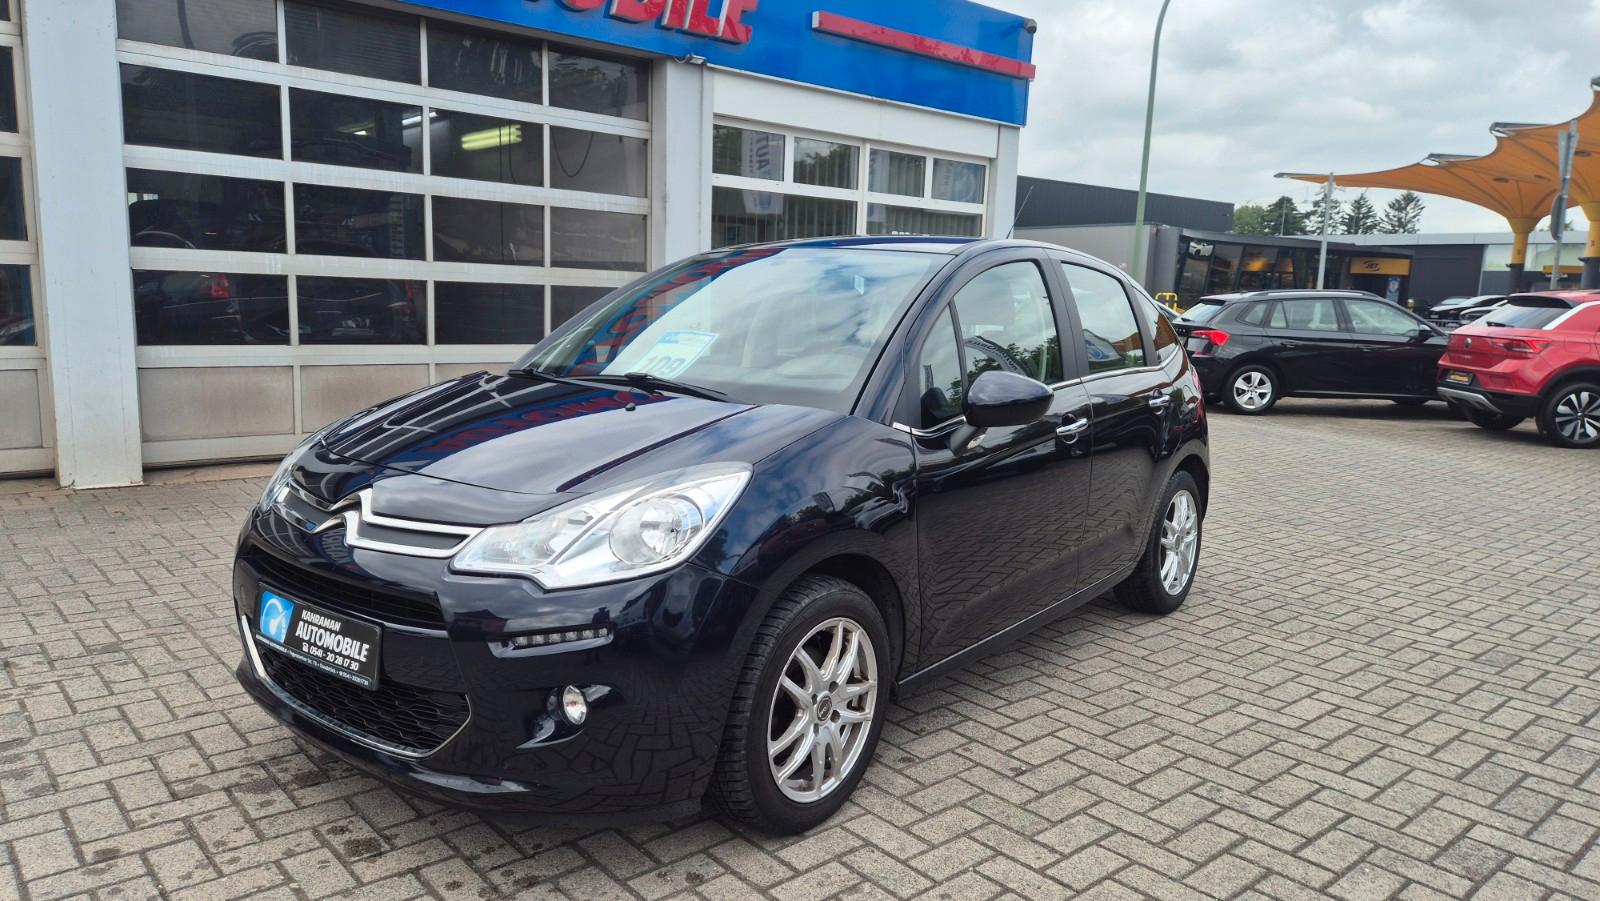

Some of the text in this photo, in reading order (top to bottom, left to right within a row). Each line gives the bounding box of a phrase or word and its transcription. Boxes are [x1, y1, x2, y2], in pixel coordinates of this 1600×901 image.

[301, 609, 341, 632] KAHRAMAN
[295, 620, 370, 663] AUTOMOBILE
[309, 645, 324, 658] 0541
[326, 652, 335, 662] 20
[334, 654, 344, 666] 28
[343, 658, 350, 668] 17
[349, 660, 359, 671] 30
